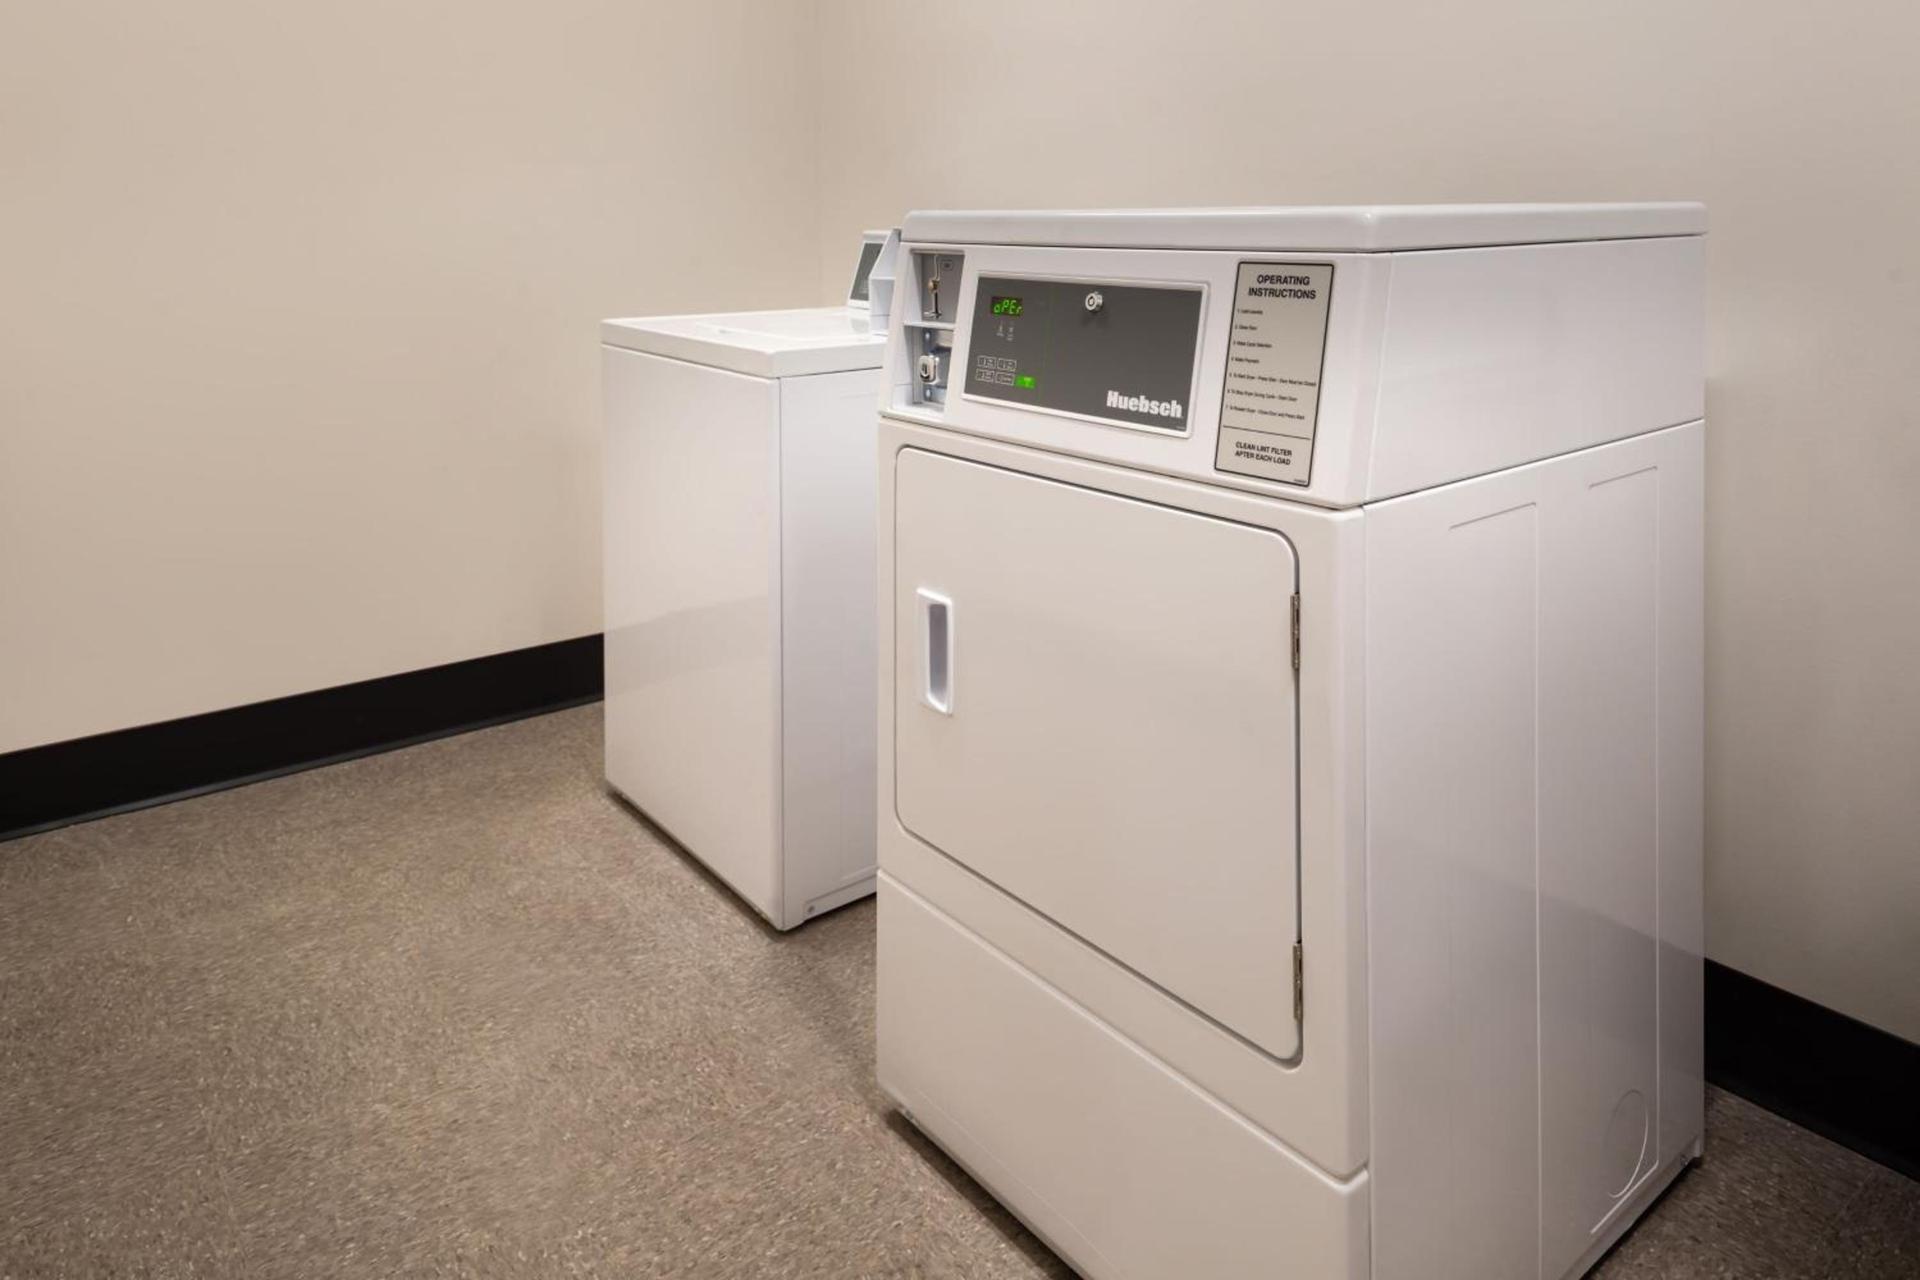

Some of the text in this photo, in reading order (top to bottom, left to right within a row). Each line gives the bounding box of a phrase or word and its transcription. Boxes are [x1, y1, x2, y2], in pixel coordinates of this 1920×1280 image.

[1257, 274, 1310, 286] OPERATING
[1248, 287, 1316, 299] INSTRUCTIONS
[1106, 390, 1182, 418] Huebsch
[1235, 441, 1256, 451] CLEAN
[1271, 447, 1292, 456] FILTER
[1235, 450, 1291, 465] AFTER EACH LOAD
